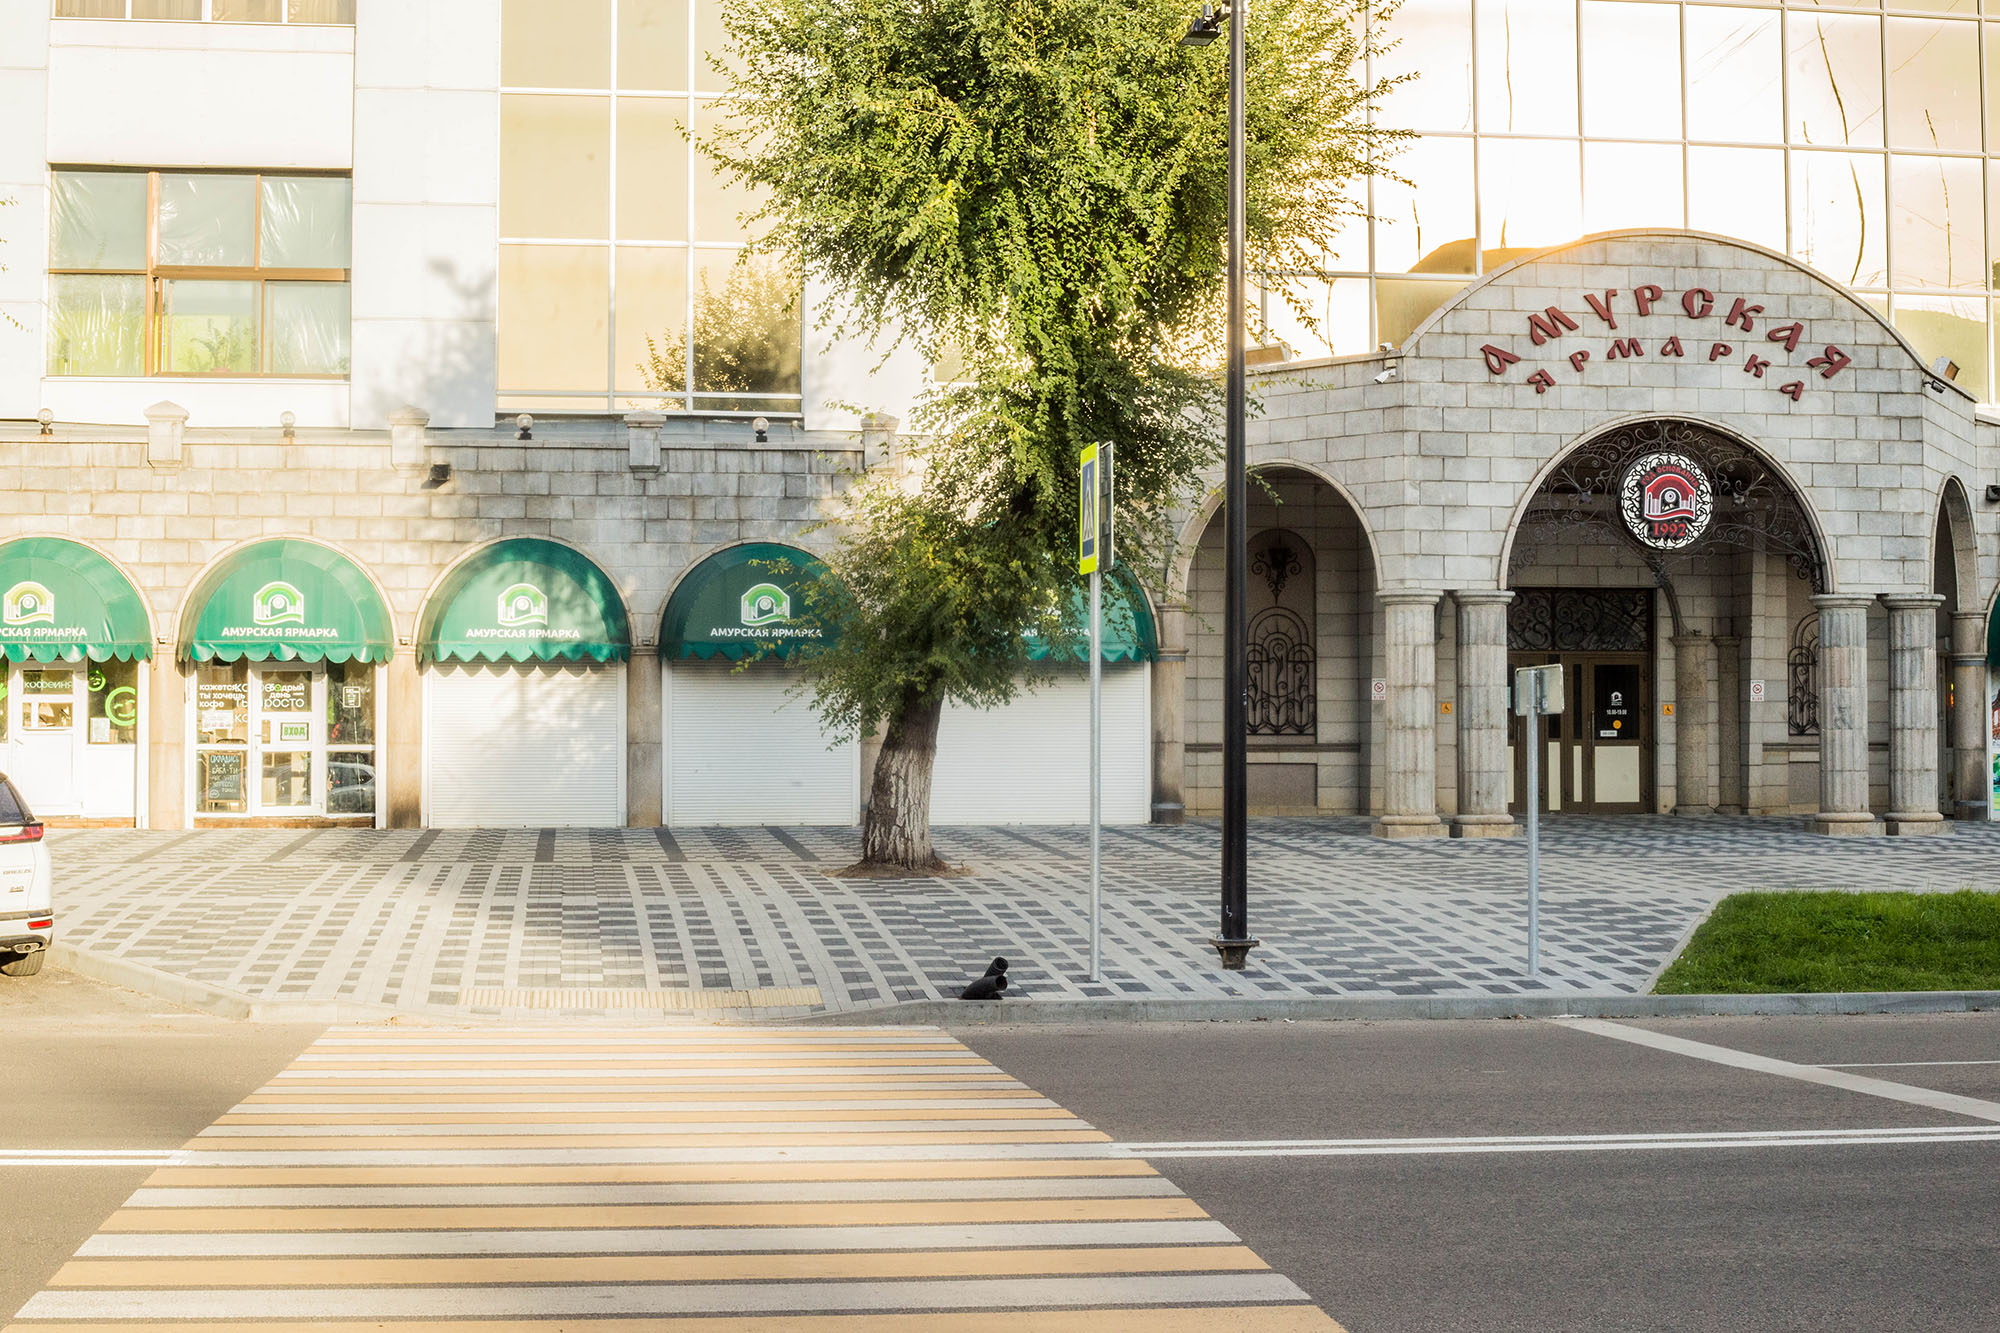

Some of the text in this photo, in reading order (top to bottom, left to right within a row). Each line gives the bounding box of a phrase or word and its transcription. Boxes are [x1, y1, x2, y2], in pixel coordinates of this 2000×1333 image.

[1480, 284, 1852, 379] АМУРСКАЯ
[1526, 336, 1805, 401] ЯРМАРКА
[1653, 522, 1687, 537] 1992
[33, 627, 87, 637] ЯРМАРКА
[221, 627, 338, 638] АМУРСКАЯ ЯРМАРКА
[466, 628, 580, 639] АМУРСКАЯ ЯРМАРКА
[710, 627, 769, 638] АМУРСКАЯ
[199, 699, 225, 710] кофе
[283, 726, 306, 737] ВХОД
